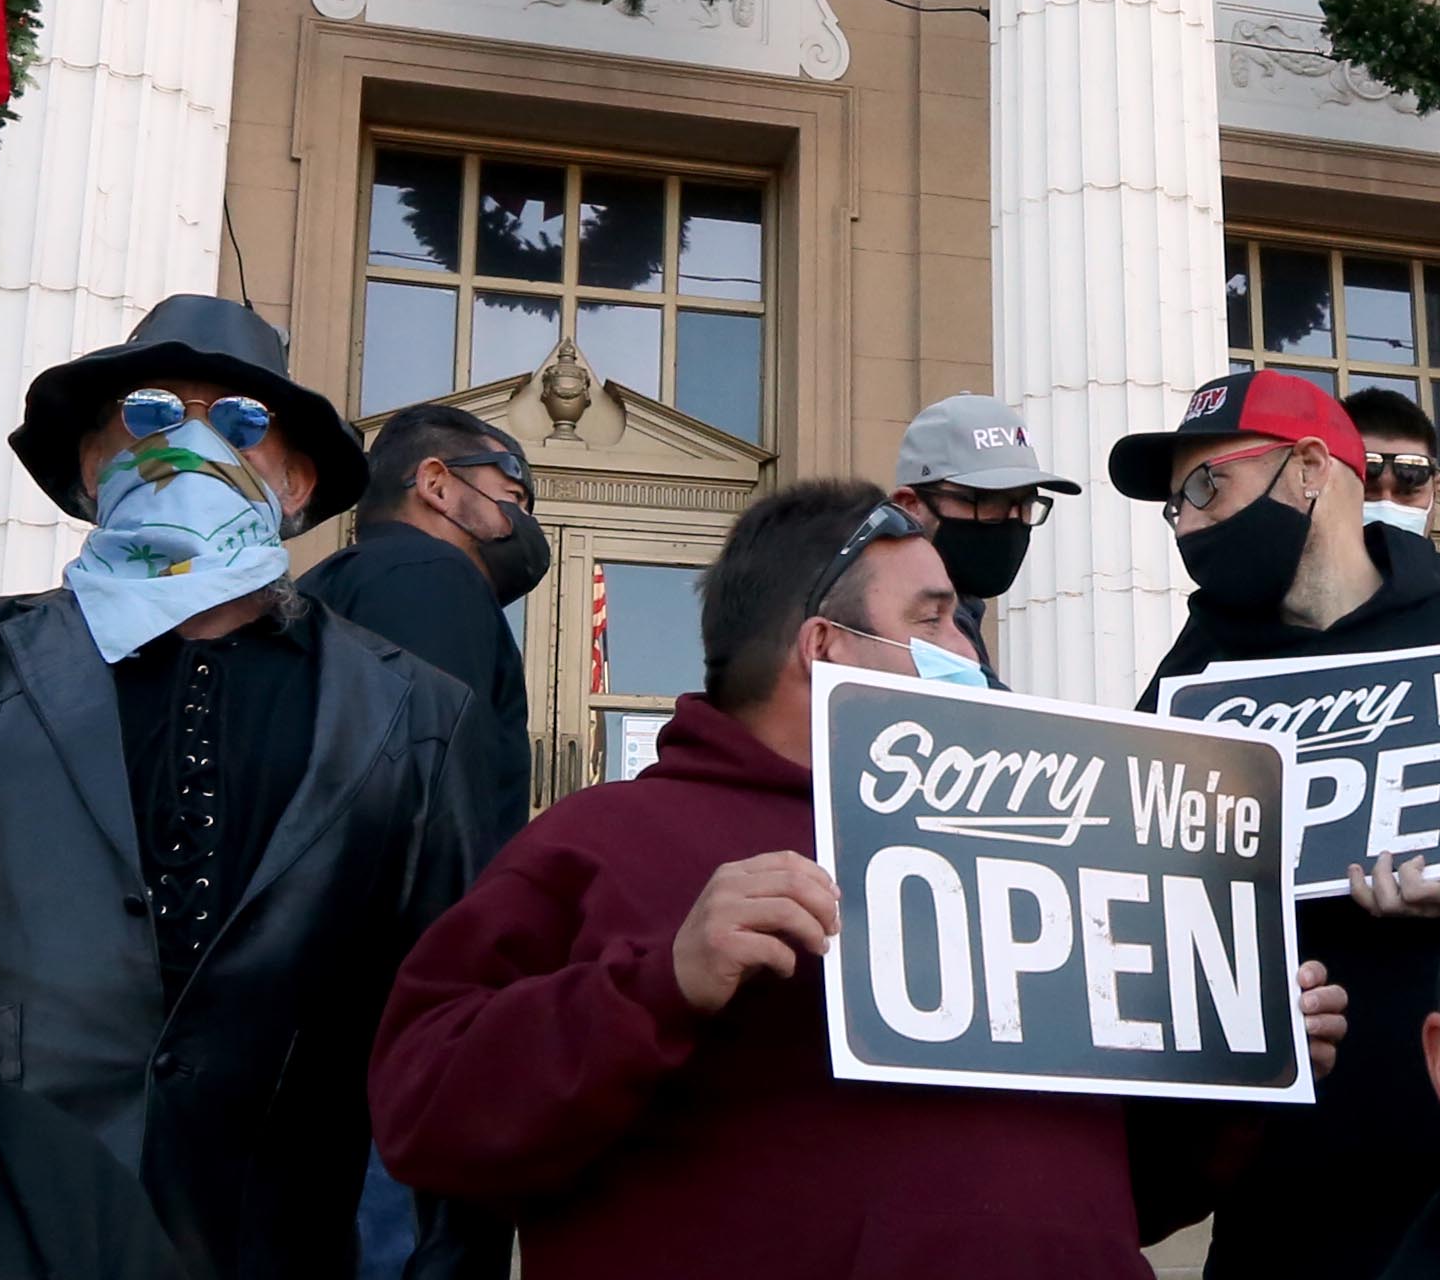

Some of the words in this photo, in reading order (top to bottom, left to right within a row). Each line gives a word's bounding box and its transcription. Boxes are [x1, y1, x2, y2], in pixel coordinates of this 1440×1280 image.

[859, 720, 1109, 847] Sorry
[1126, 755, 1261, 858] We're
[864, 845, 1267, 1053] OPEN
